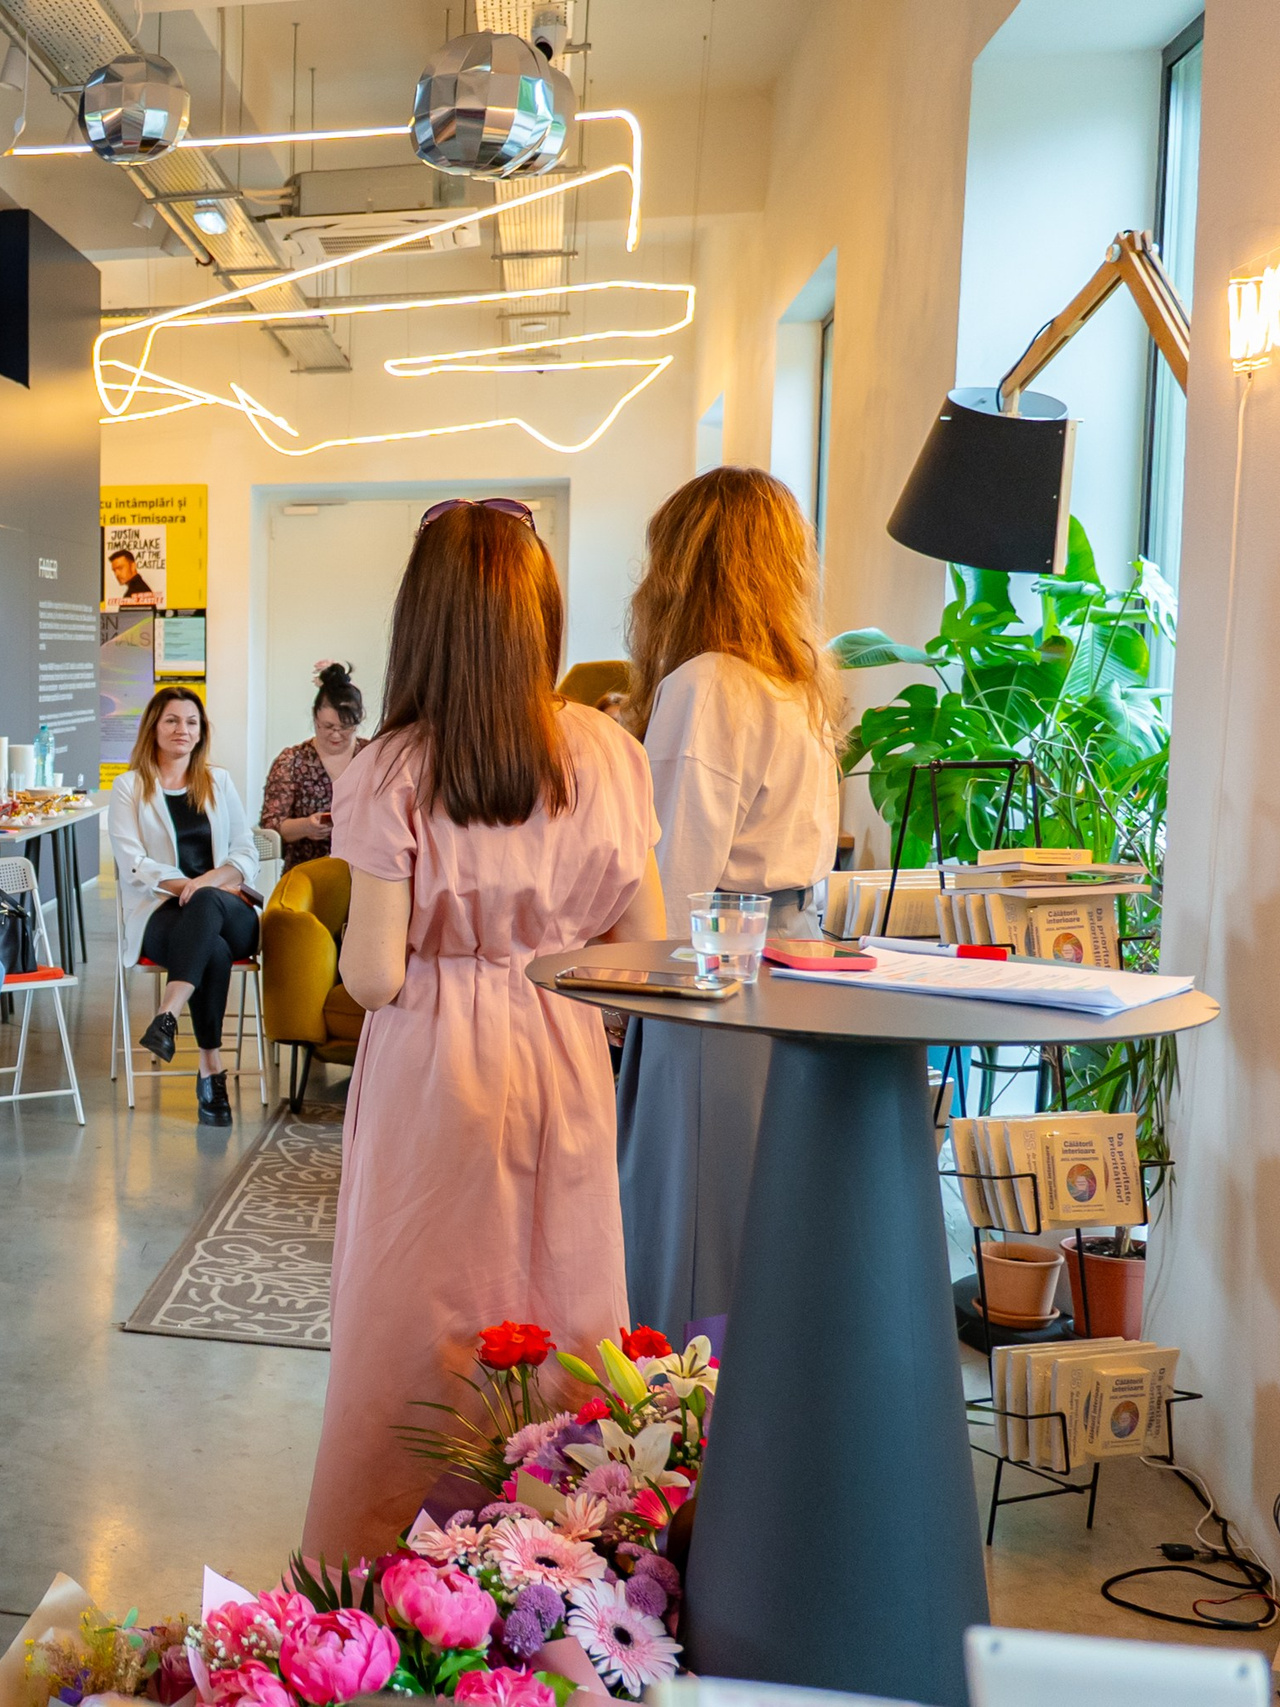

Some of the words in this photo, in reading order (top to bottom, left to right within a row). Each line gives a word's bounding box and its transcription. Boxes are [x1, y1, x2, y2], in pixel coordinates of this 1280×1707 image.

[115, 497, 173, 510] întâmplări
[178, 497, 187, 511] și
[110, 514, 127, 524] din
[111, 529, 140, 541] JUSTIN
[107, 537, 161, 551] TIMBERLAKE
[135, 551, 146, 561] AT
[147, 550, 161, 560] THE
[136, 559, 166, 570] CASTLE
[1046, 916, 1081, 925] interioare
[1061, 1147, 1096, 1155] interioare
